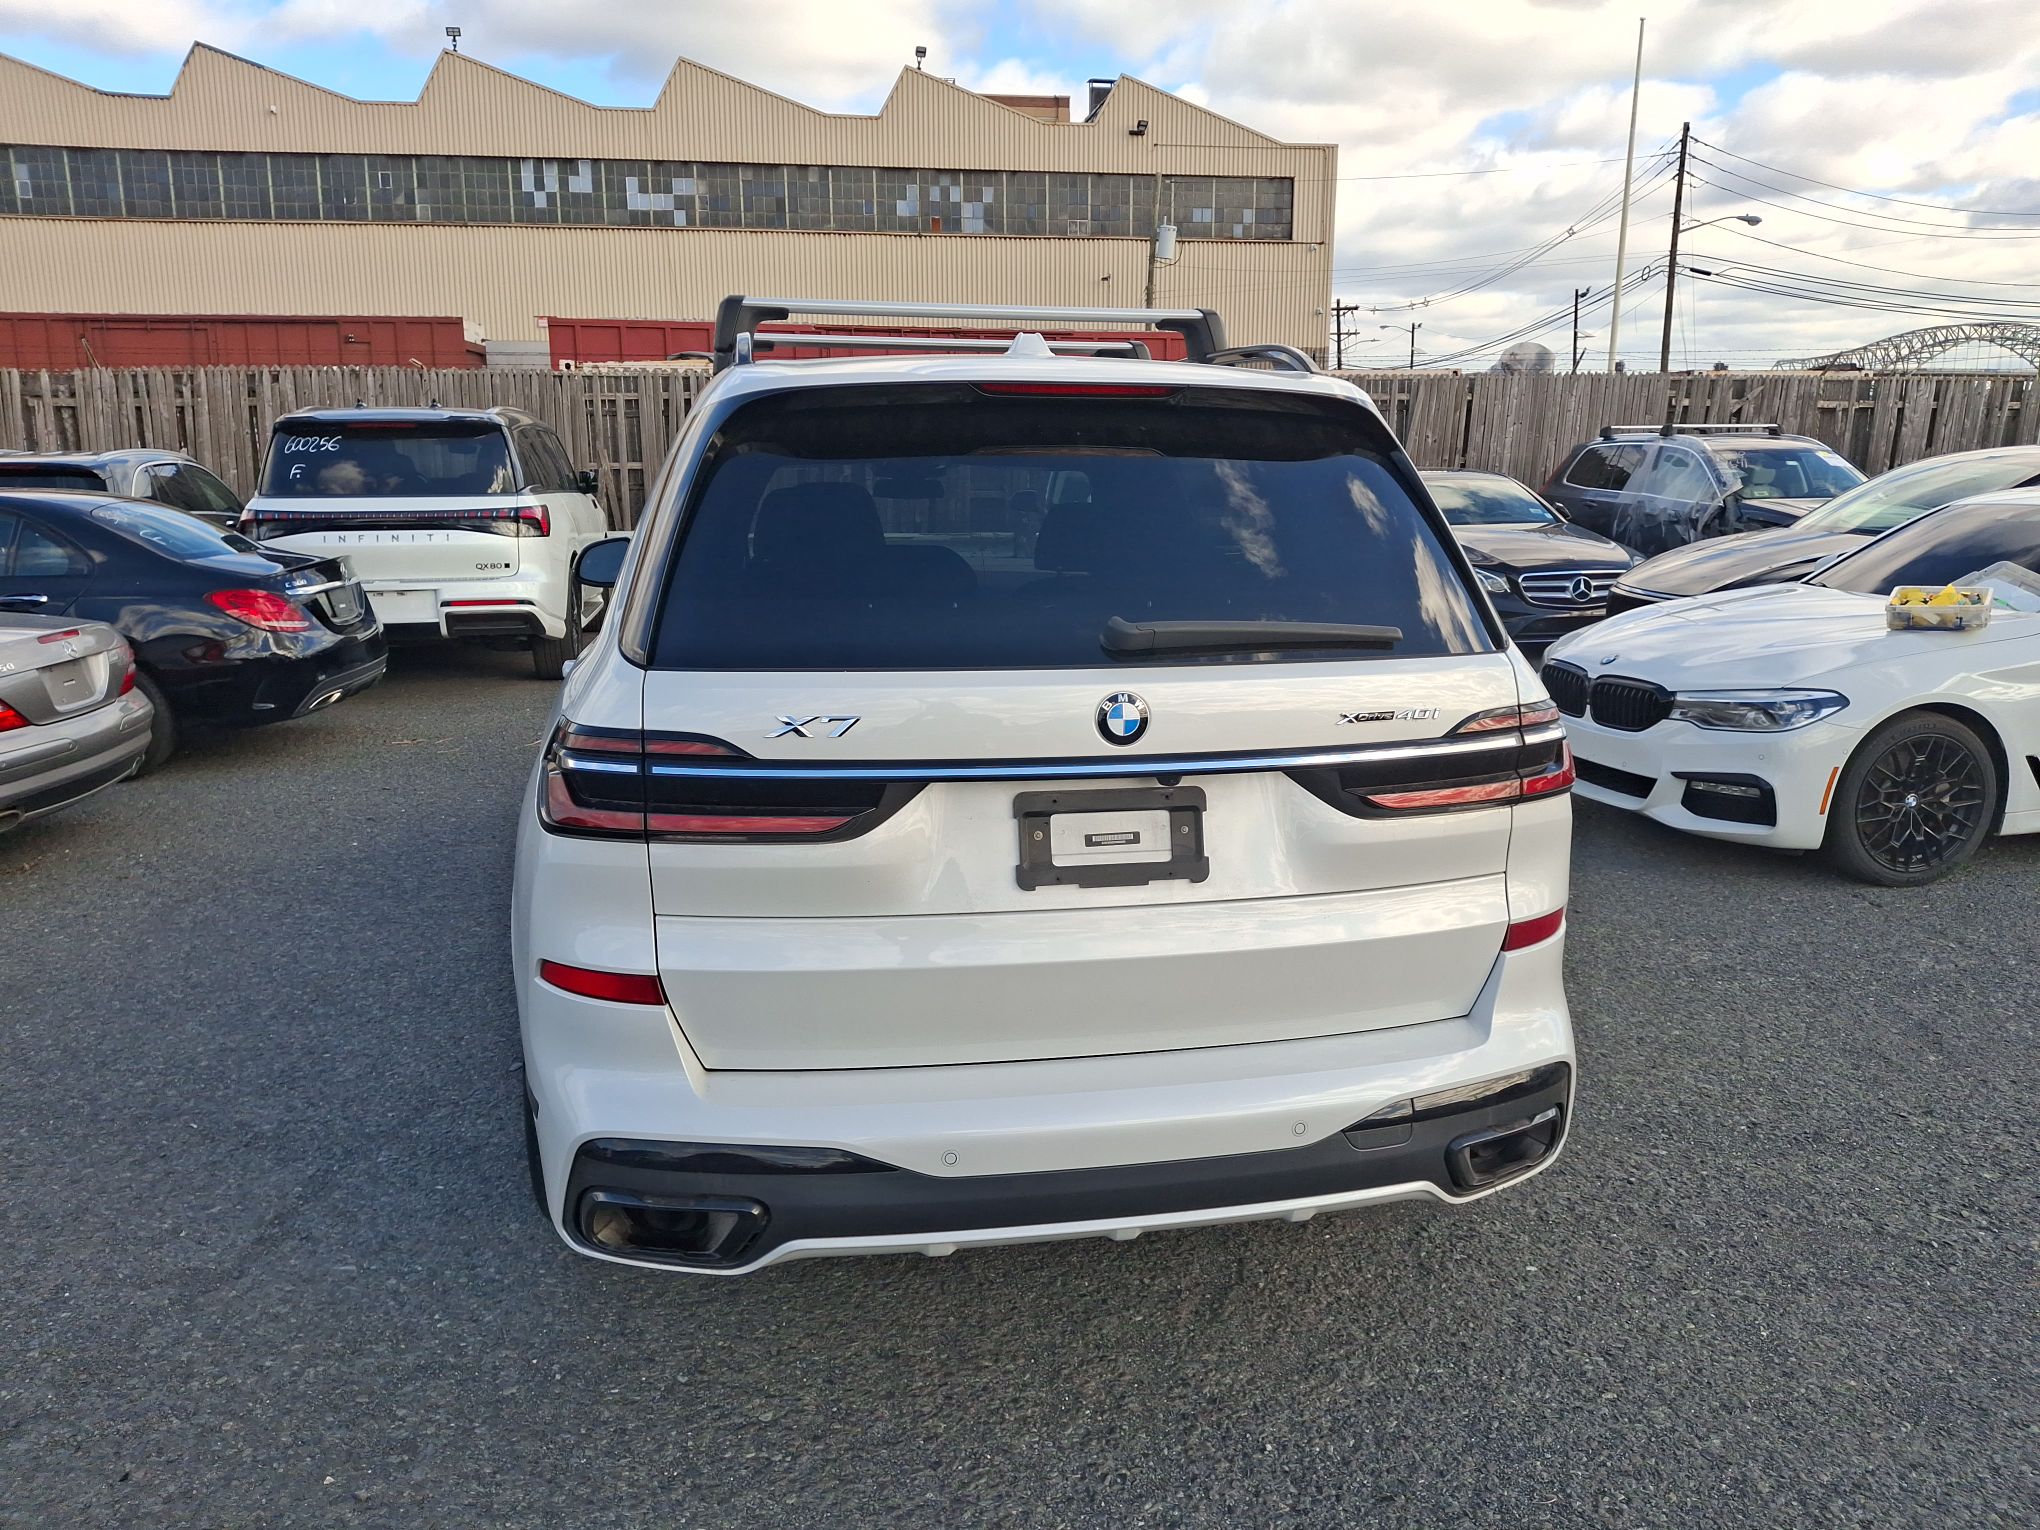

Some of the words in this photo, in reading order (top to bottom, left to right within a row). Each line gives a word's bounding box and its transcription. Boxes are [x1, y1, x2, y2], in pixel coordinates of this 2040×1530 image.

[284, 435, 342, 454] 600256
[322, 533, 450, 544] INFINITI
[475, 562, 503, 571] QX80
[1102, 693, 1145, 711] BMW
[763, 715, 862, 738] X7
